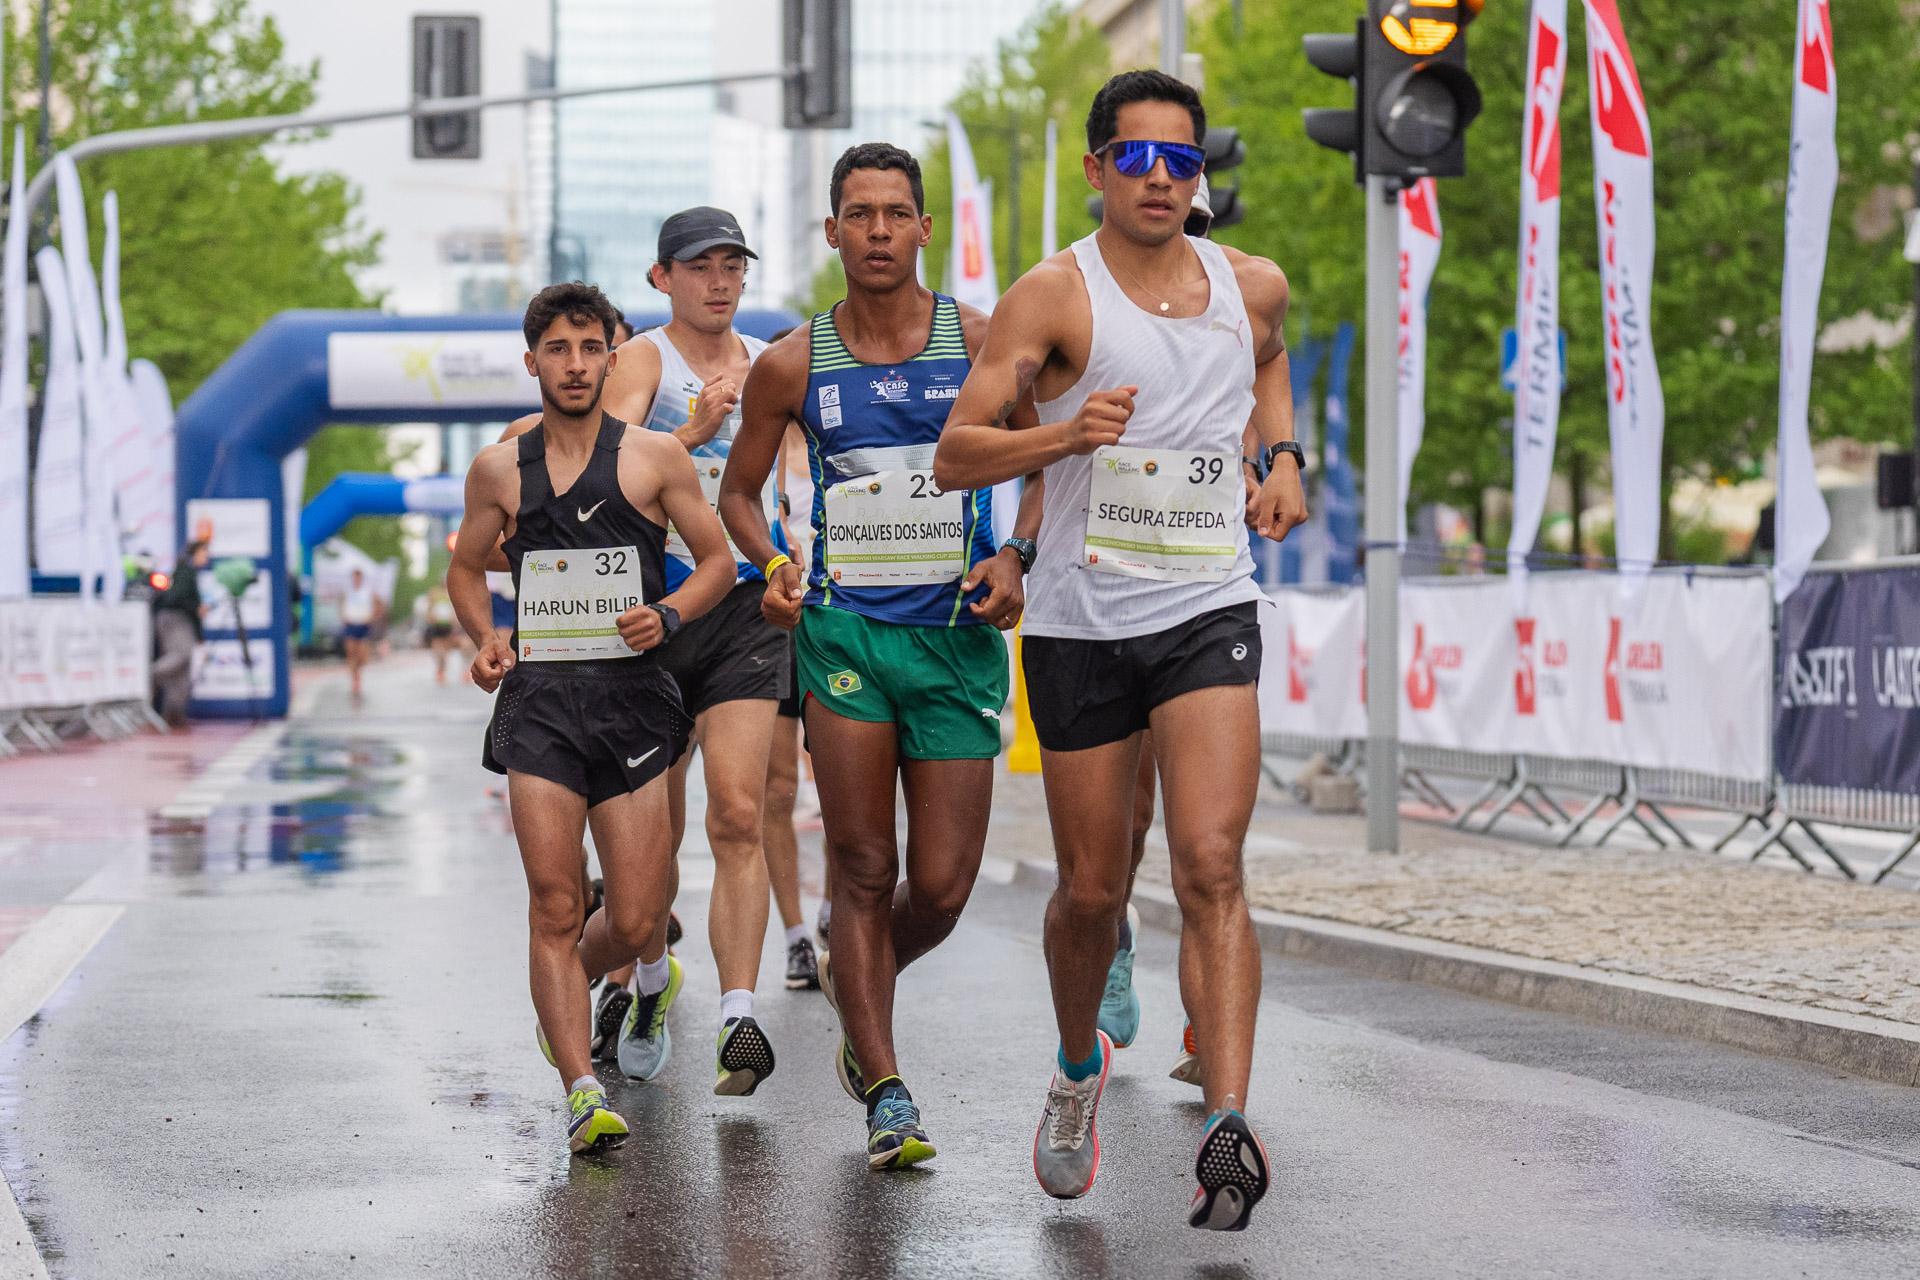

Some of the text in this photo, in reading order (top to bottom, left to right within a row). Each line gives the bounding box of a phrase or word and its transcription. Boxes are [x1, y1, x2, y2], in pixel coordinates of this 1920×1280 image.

[1188, 456, 1224, 485] 39
[1098, 503, 1226, 529] SEGURA ZEPEDA
[829, 521, 963, 544] GONÇALVES DOS SANTOS
[595, 551, 628, 576] 32
[524, 596, 639, 616] HARUN BILIR
